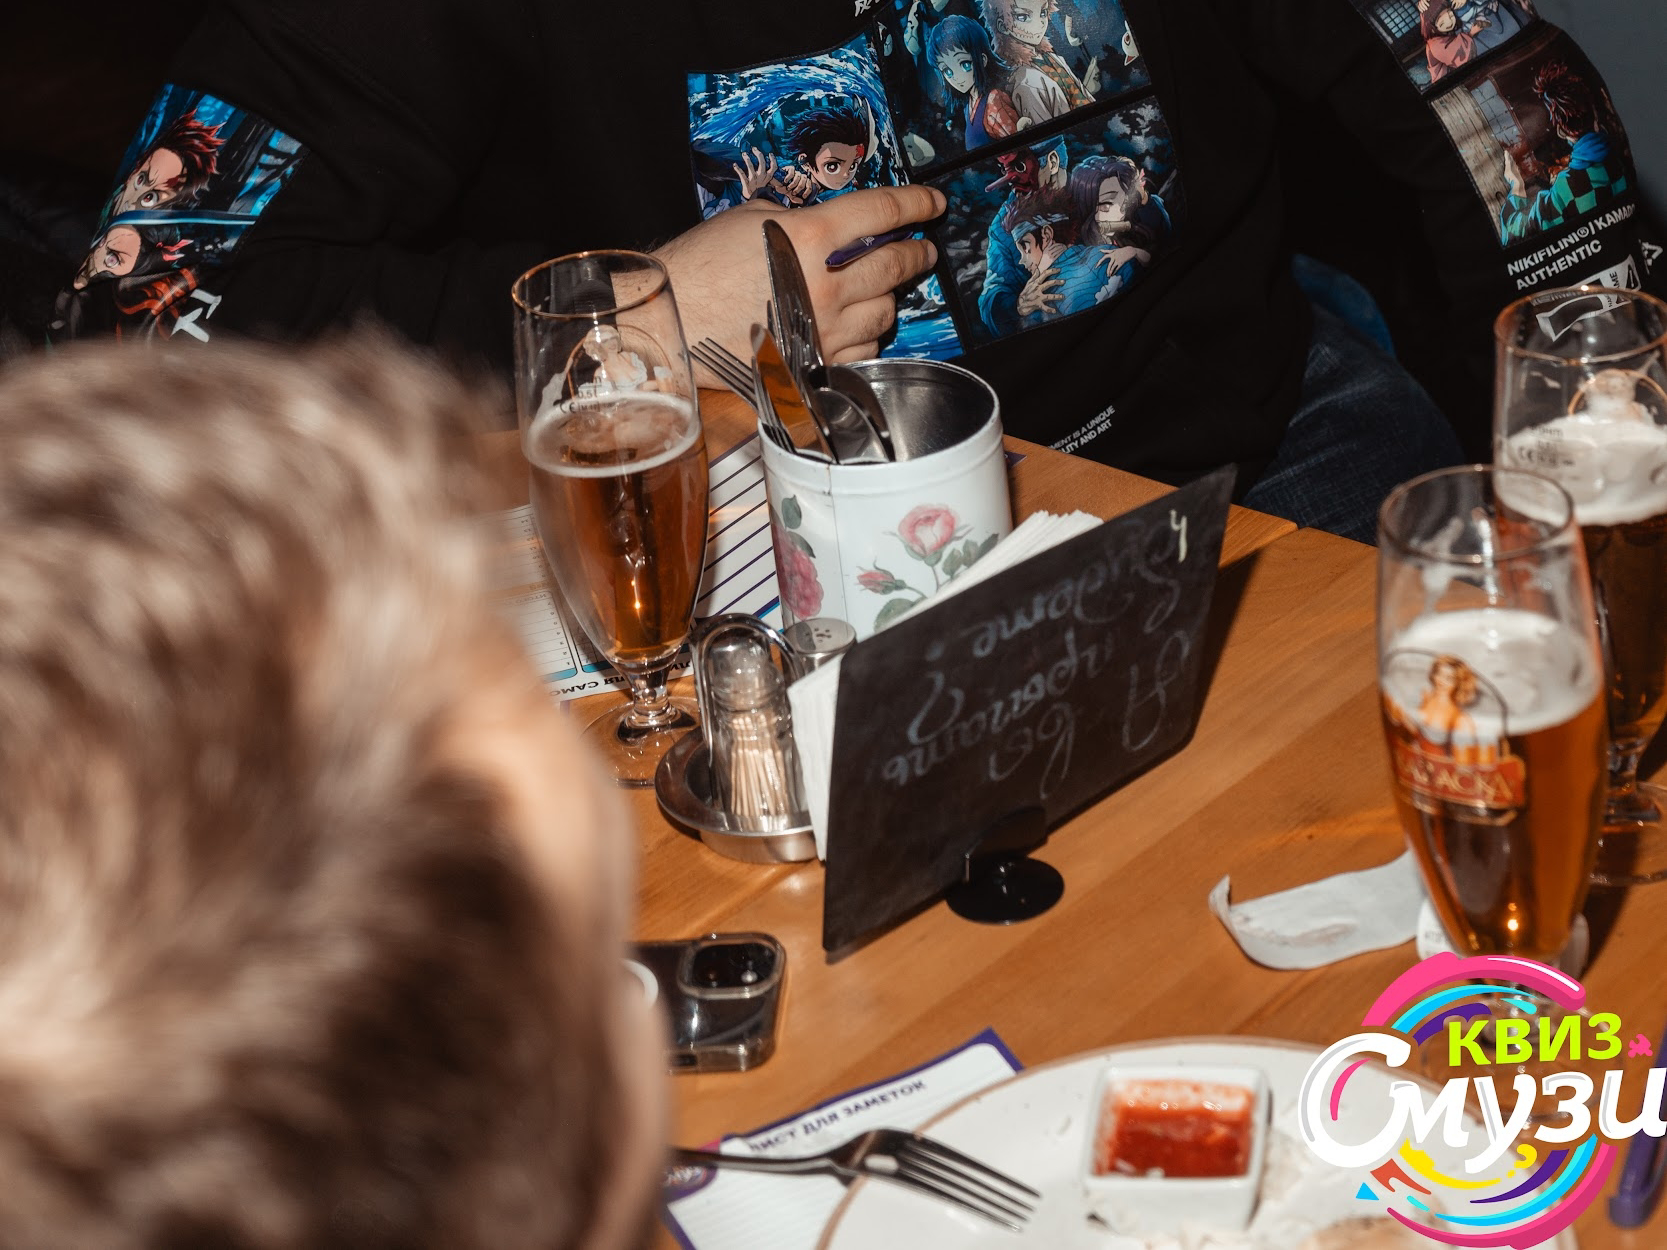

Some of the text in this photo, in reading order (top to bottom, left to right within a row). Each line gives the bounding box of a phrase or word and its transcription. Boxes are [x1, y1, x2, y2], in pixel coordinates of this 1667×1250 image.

[1517, 239, 1602, 290] AUTHENTIC
[1048, 405, 1116, 450] MENT IS A UNIQUE
[1080, 430, 1097, 446] AND
[1096, 419, 1112, 434] ART
[802, 1111, 840, 1137] ДЛЯ
[844, 1079, 927, 1117] ЗАМЕТОК
